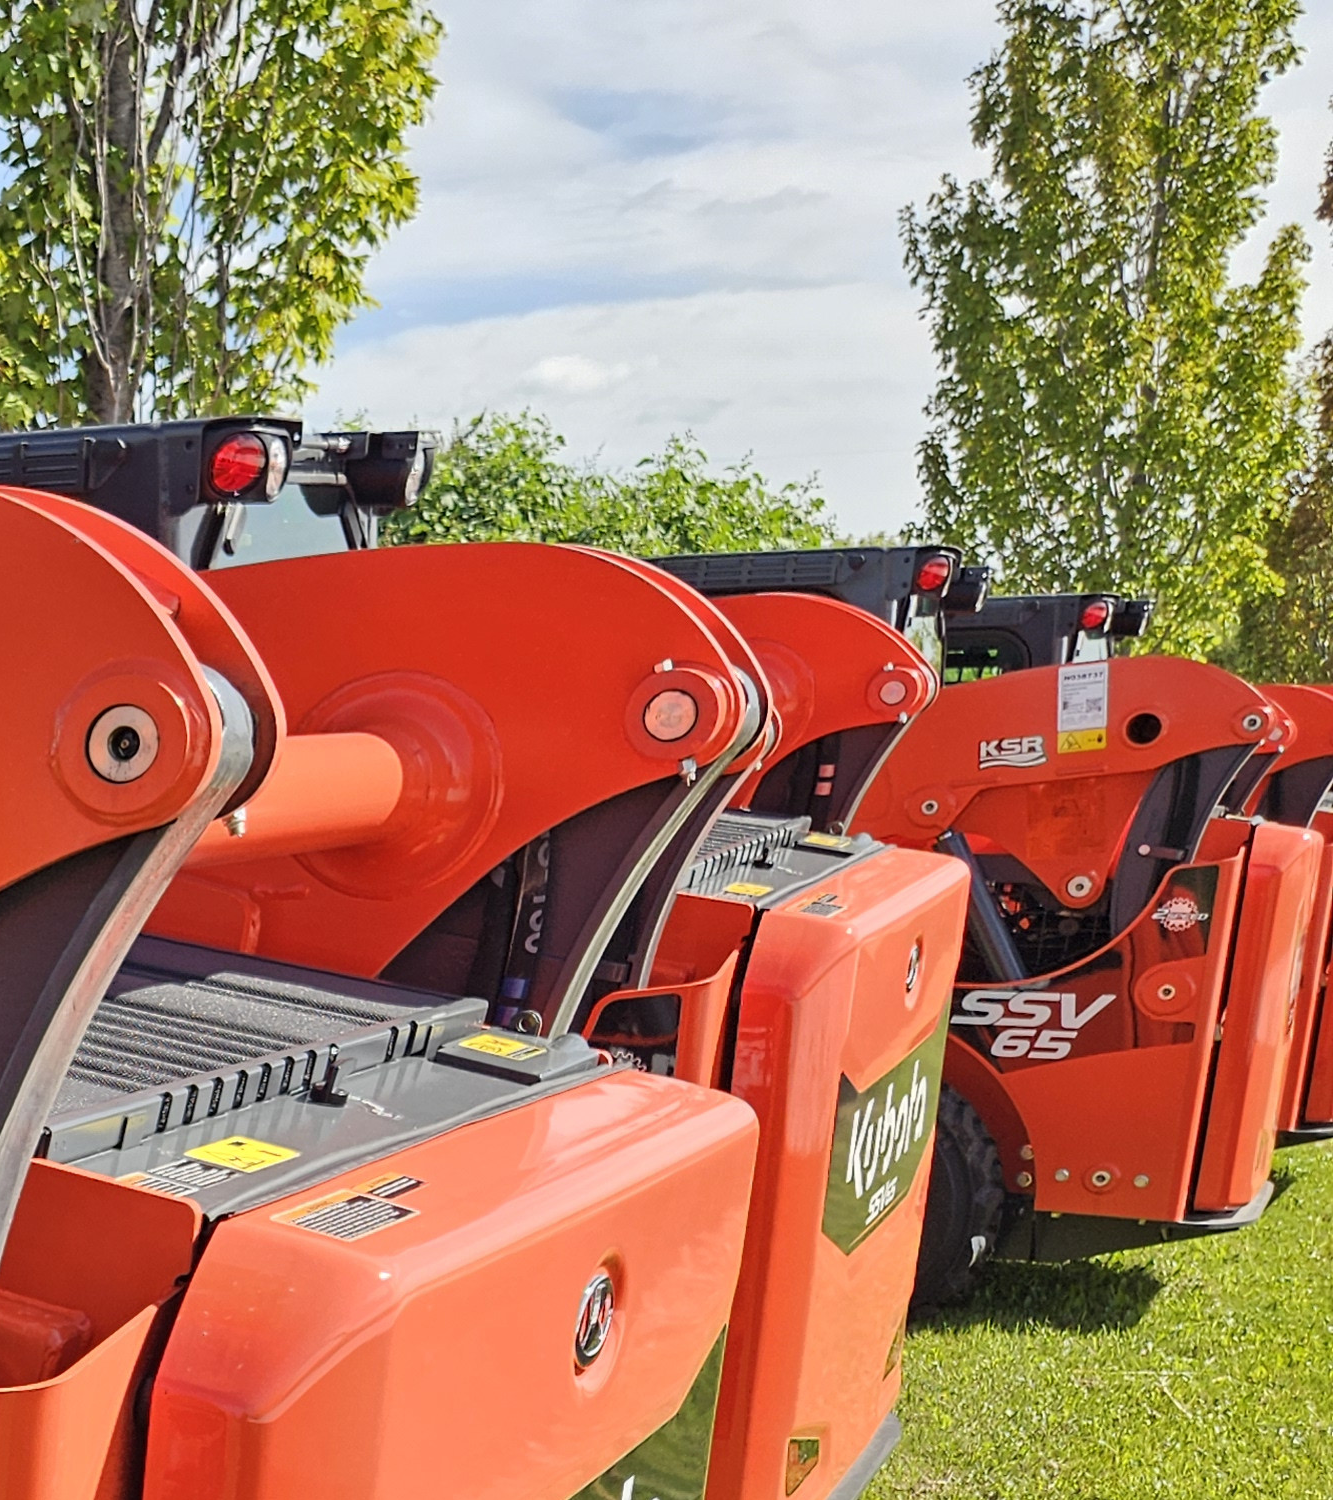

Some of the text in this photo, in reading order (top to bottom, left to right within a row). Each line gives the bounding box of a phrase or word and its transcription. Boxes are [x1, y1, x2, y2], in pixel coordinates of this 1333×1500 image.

[980, 736, 1044, 758] KSR
[950, 989, 1117, 1029] SSV
[989, 1028, 1079, 1061] 65
[846, 1059, 927, 1200] Kubota
